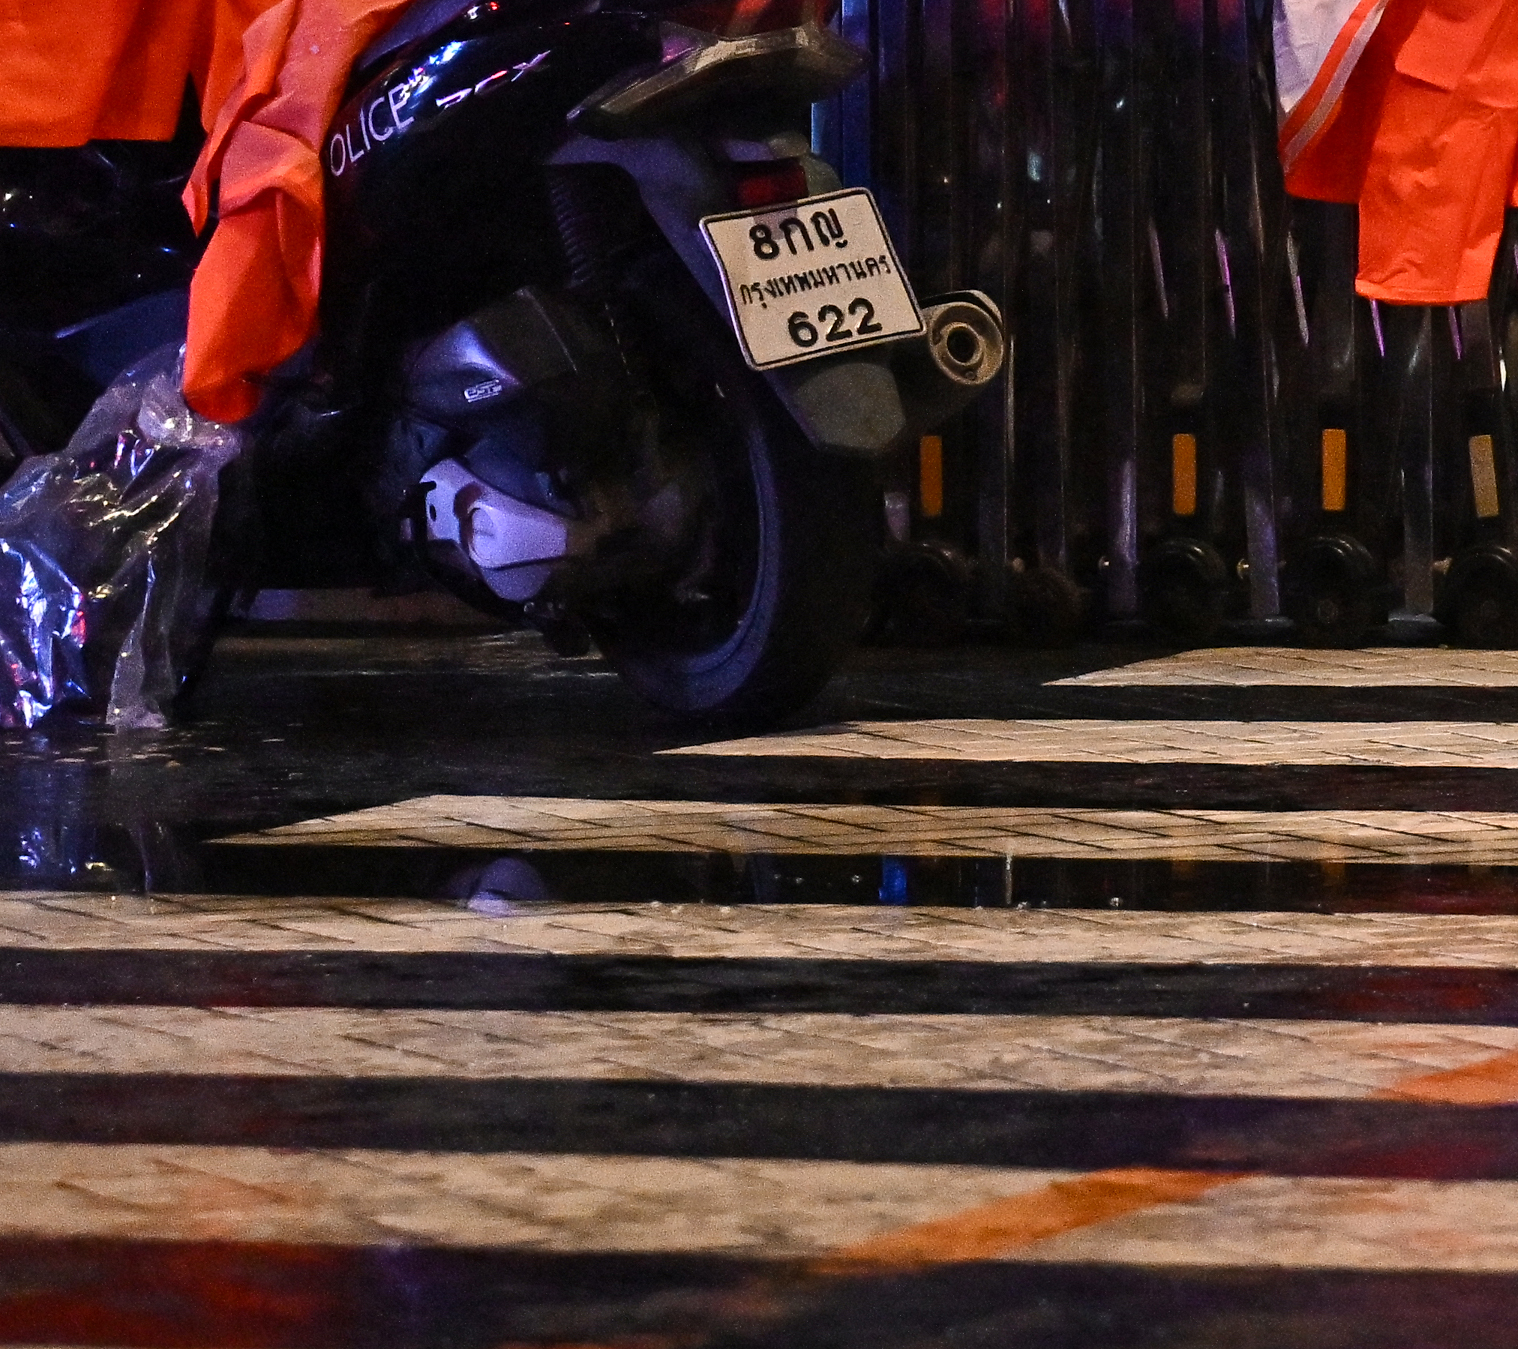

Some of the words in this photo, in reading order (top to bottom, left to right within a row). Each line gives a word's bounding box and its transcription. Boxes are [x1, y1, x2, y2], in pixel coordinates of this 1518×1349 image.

[749, 207, 849, 261] 8กญ
[738, 254, 892, 309] กรุงเทพมหานคร
[787, 297, 884, 348] 622
